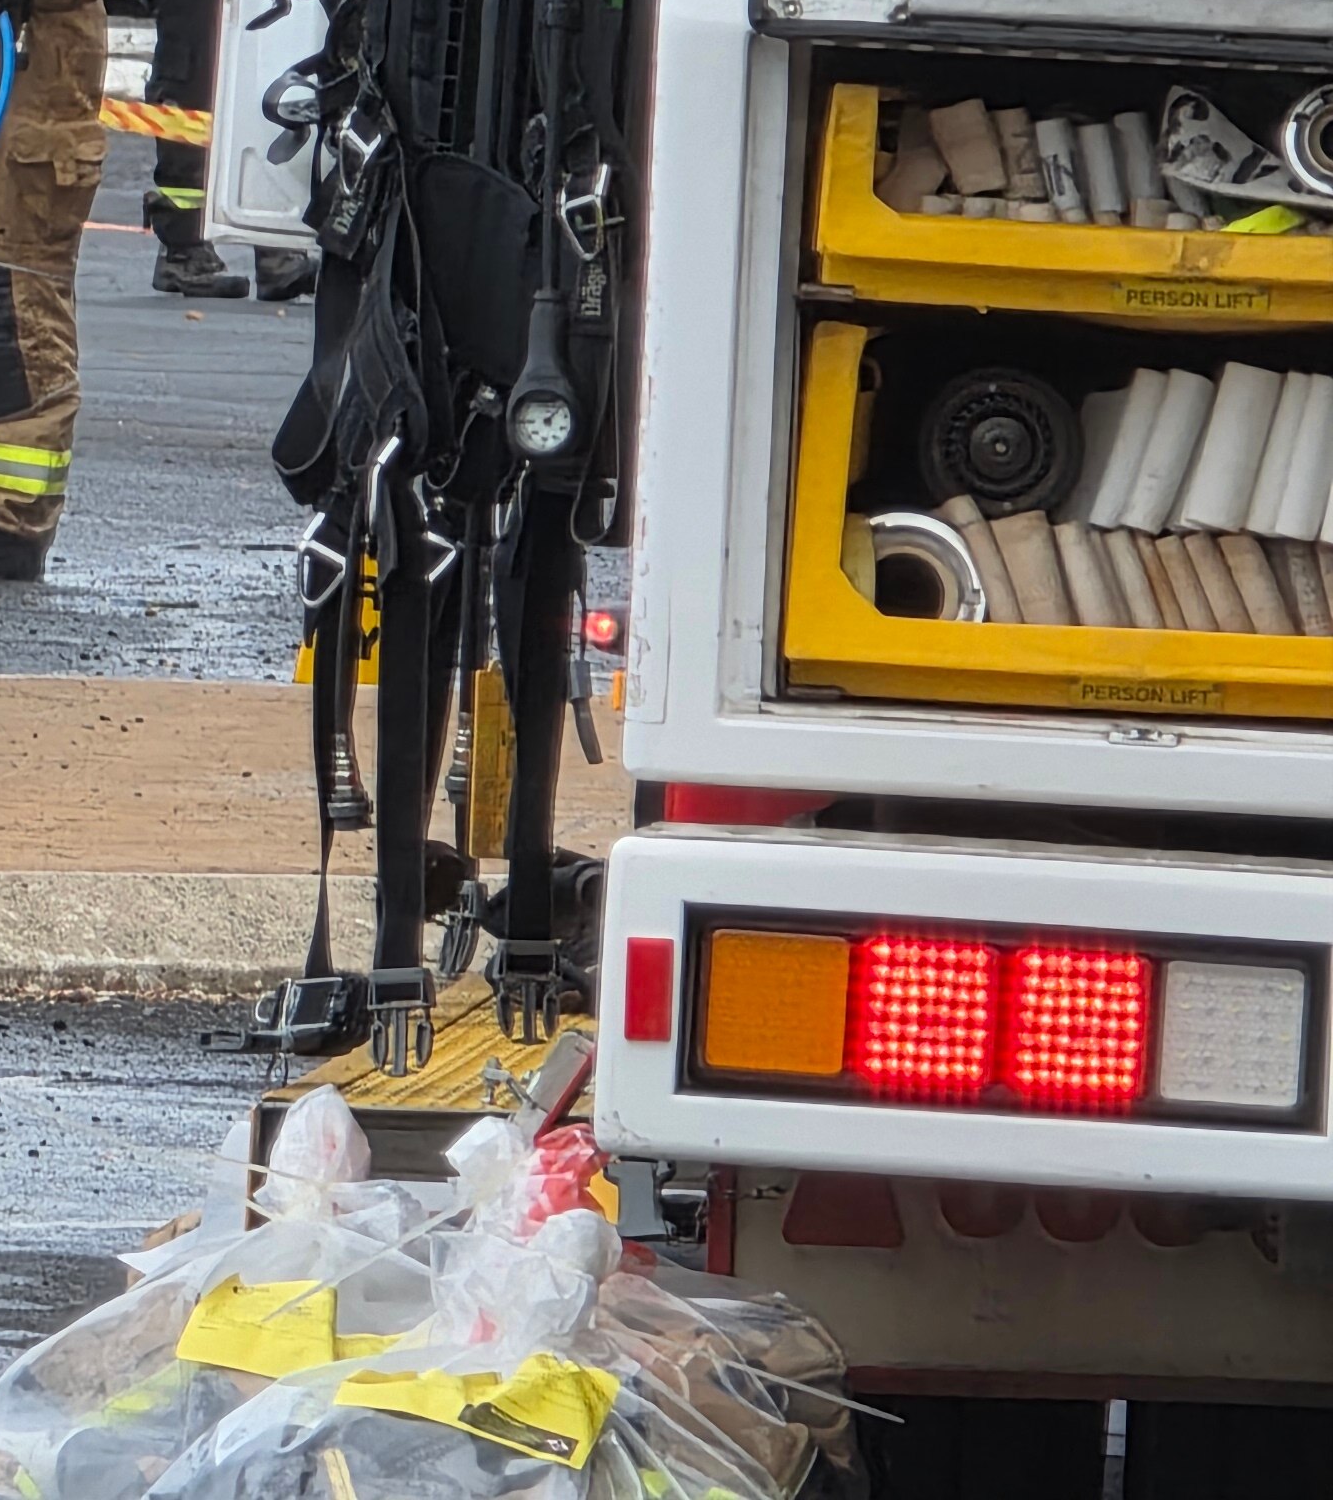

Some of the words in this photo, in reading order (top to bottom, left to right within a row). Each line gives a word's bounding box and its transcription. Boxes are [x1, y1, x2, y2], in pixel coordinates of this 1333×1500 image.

[1126, 288, 1209, 308] PERSON
[1214, 292, 1255, 309] LIFT
[1081, 683, 1164, 703] PERSON
[1170, 689, 1212, 705] LIFT
